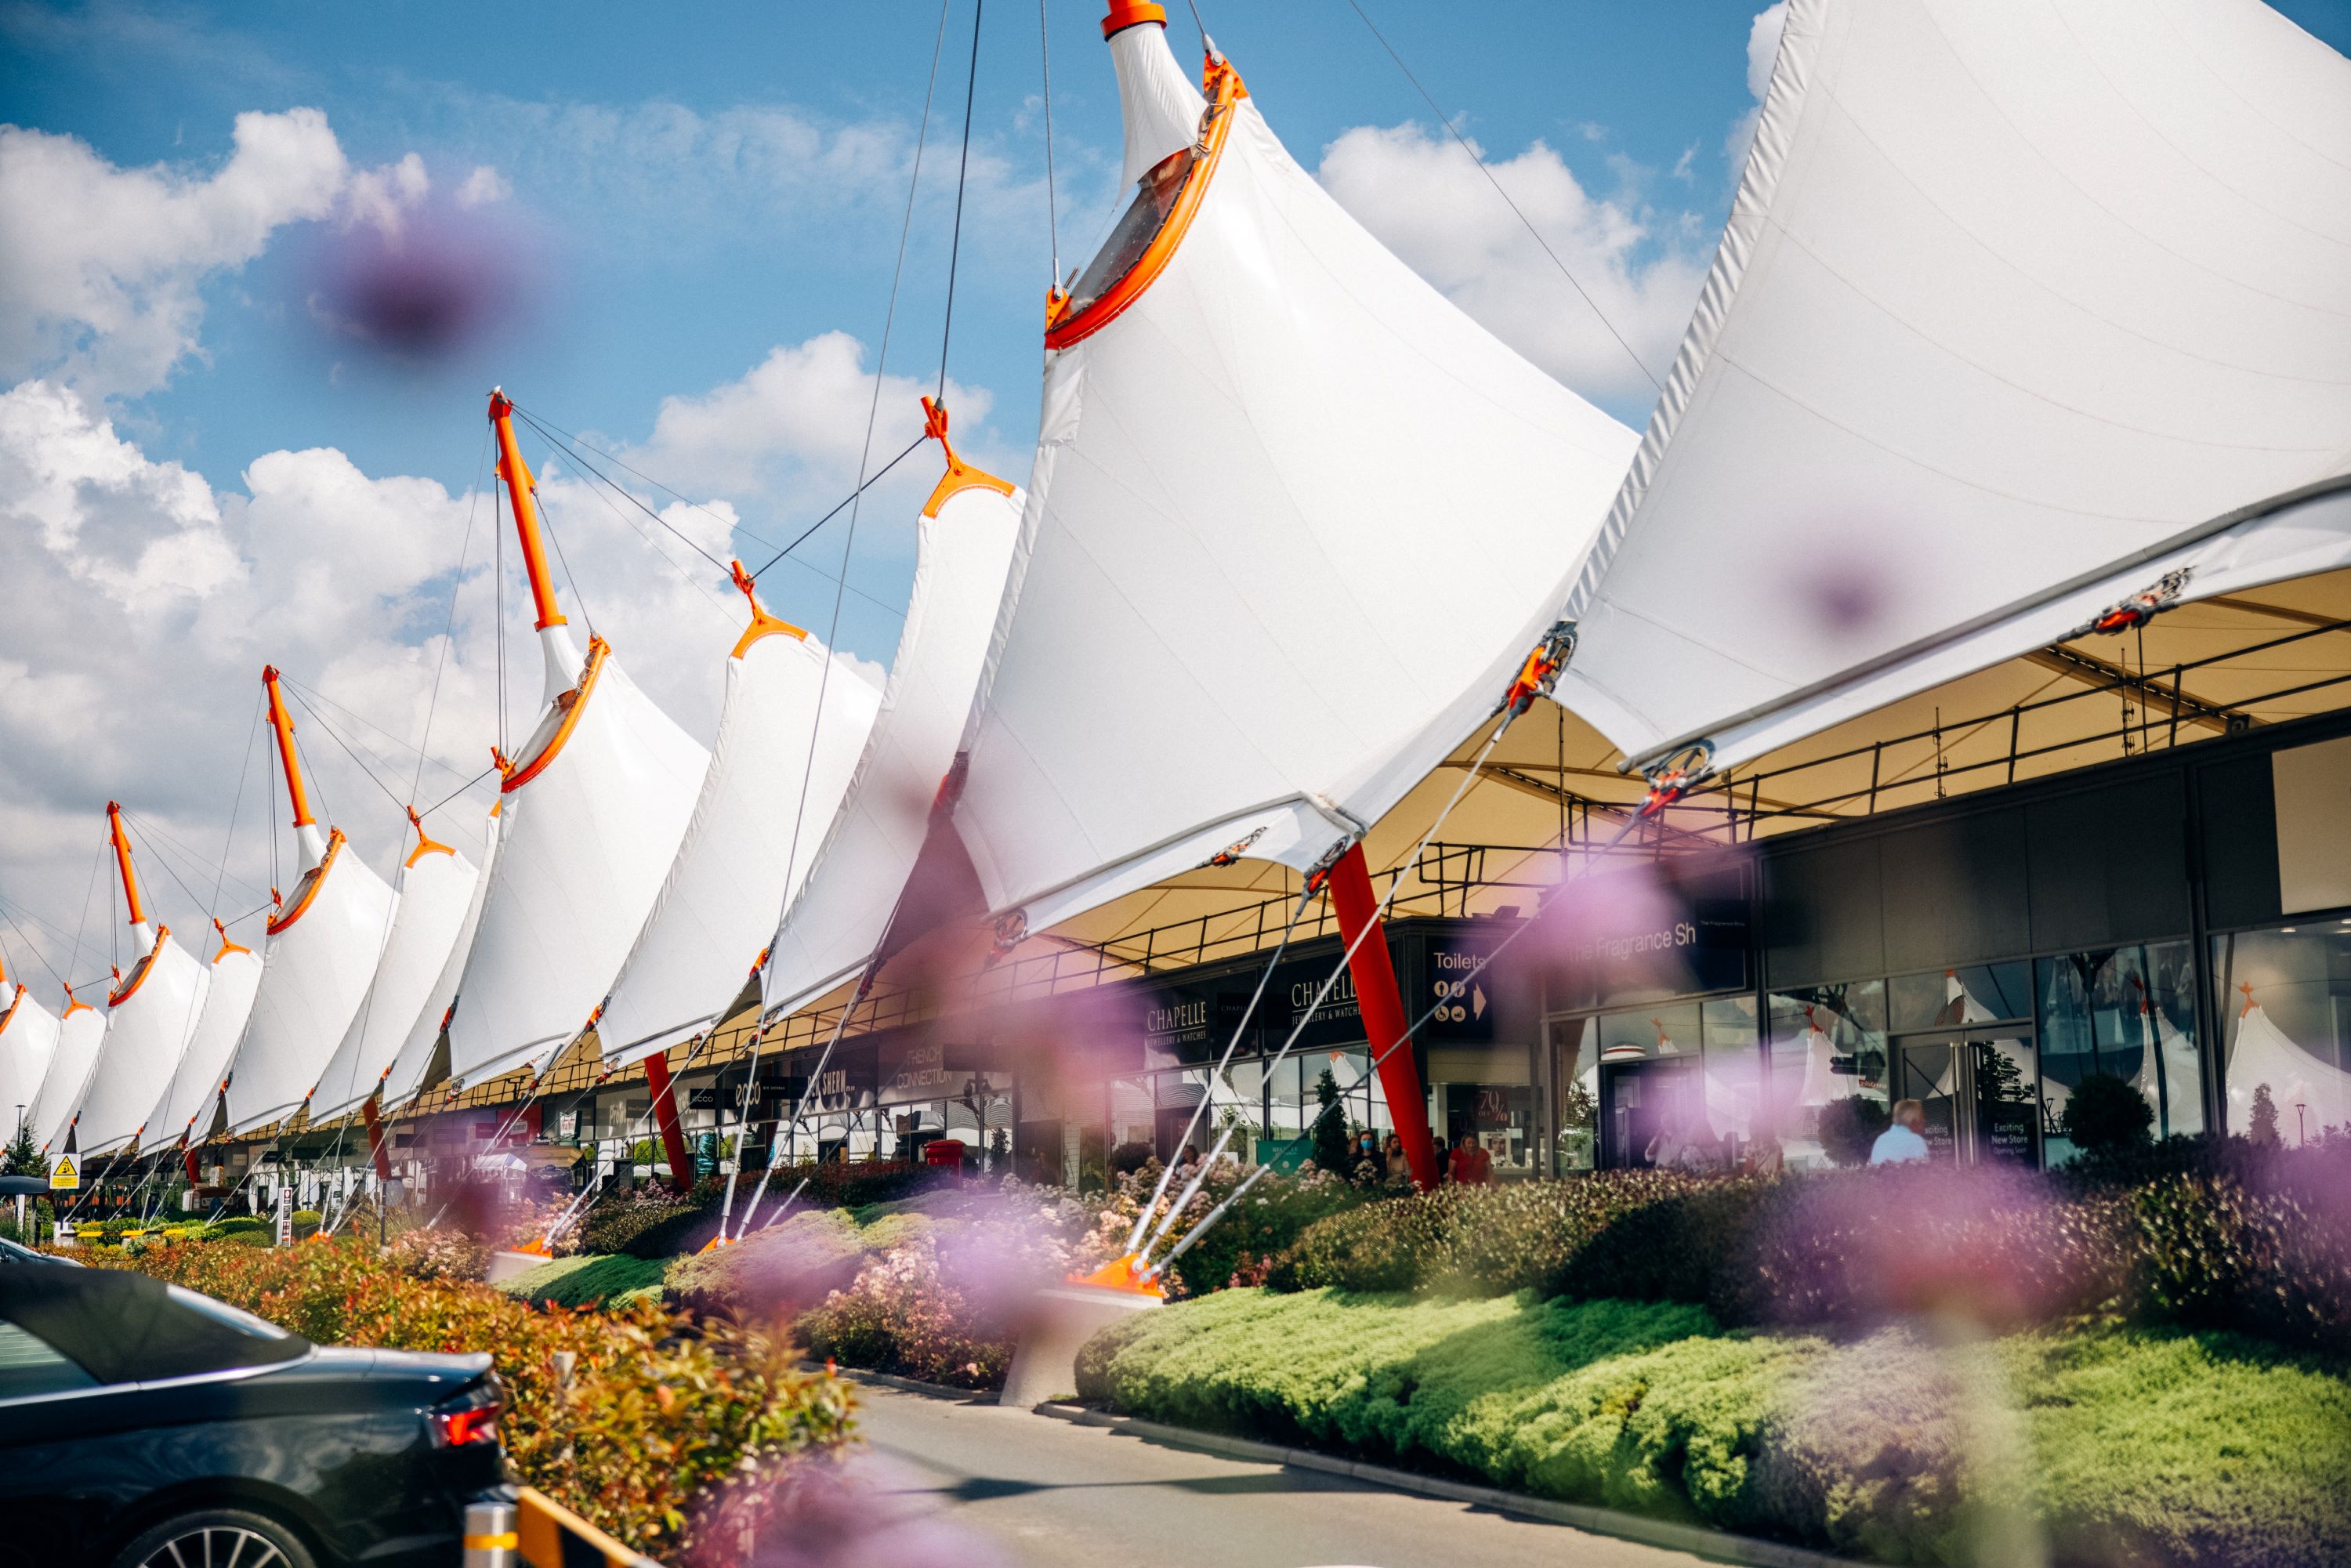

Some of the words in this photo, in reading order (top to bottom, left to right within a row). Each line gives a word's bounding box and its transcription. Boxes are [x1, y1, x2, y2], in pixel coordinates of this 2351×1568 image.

[1596, 930, 1672, 961] Fragrance
[1675, 922, 1696, 946] Sh
[1433, 952, 1487, 969] Toilets
[1291, 974, 1357, 1007] CHAPELL
[1147, 1001, 1206, 1032] CHAPELLE
[1335, 1006, 1361, 1018] WATCHE
[1182, 1030, 1206, 1042] WATCHES
[823, 1069, 856, 1095] SHERM
[897, 1066, 952, 1089] CONNECTION
[1924, 1124, 1948, 1135] xciting
[1994, 1122, 2024, 1134] Exciting
[1991, 1135, 2008, 1144] New
[2009, 1135, 2028, 1144] Store
